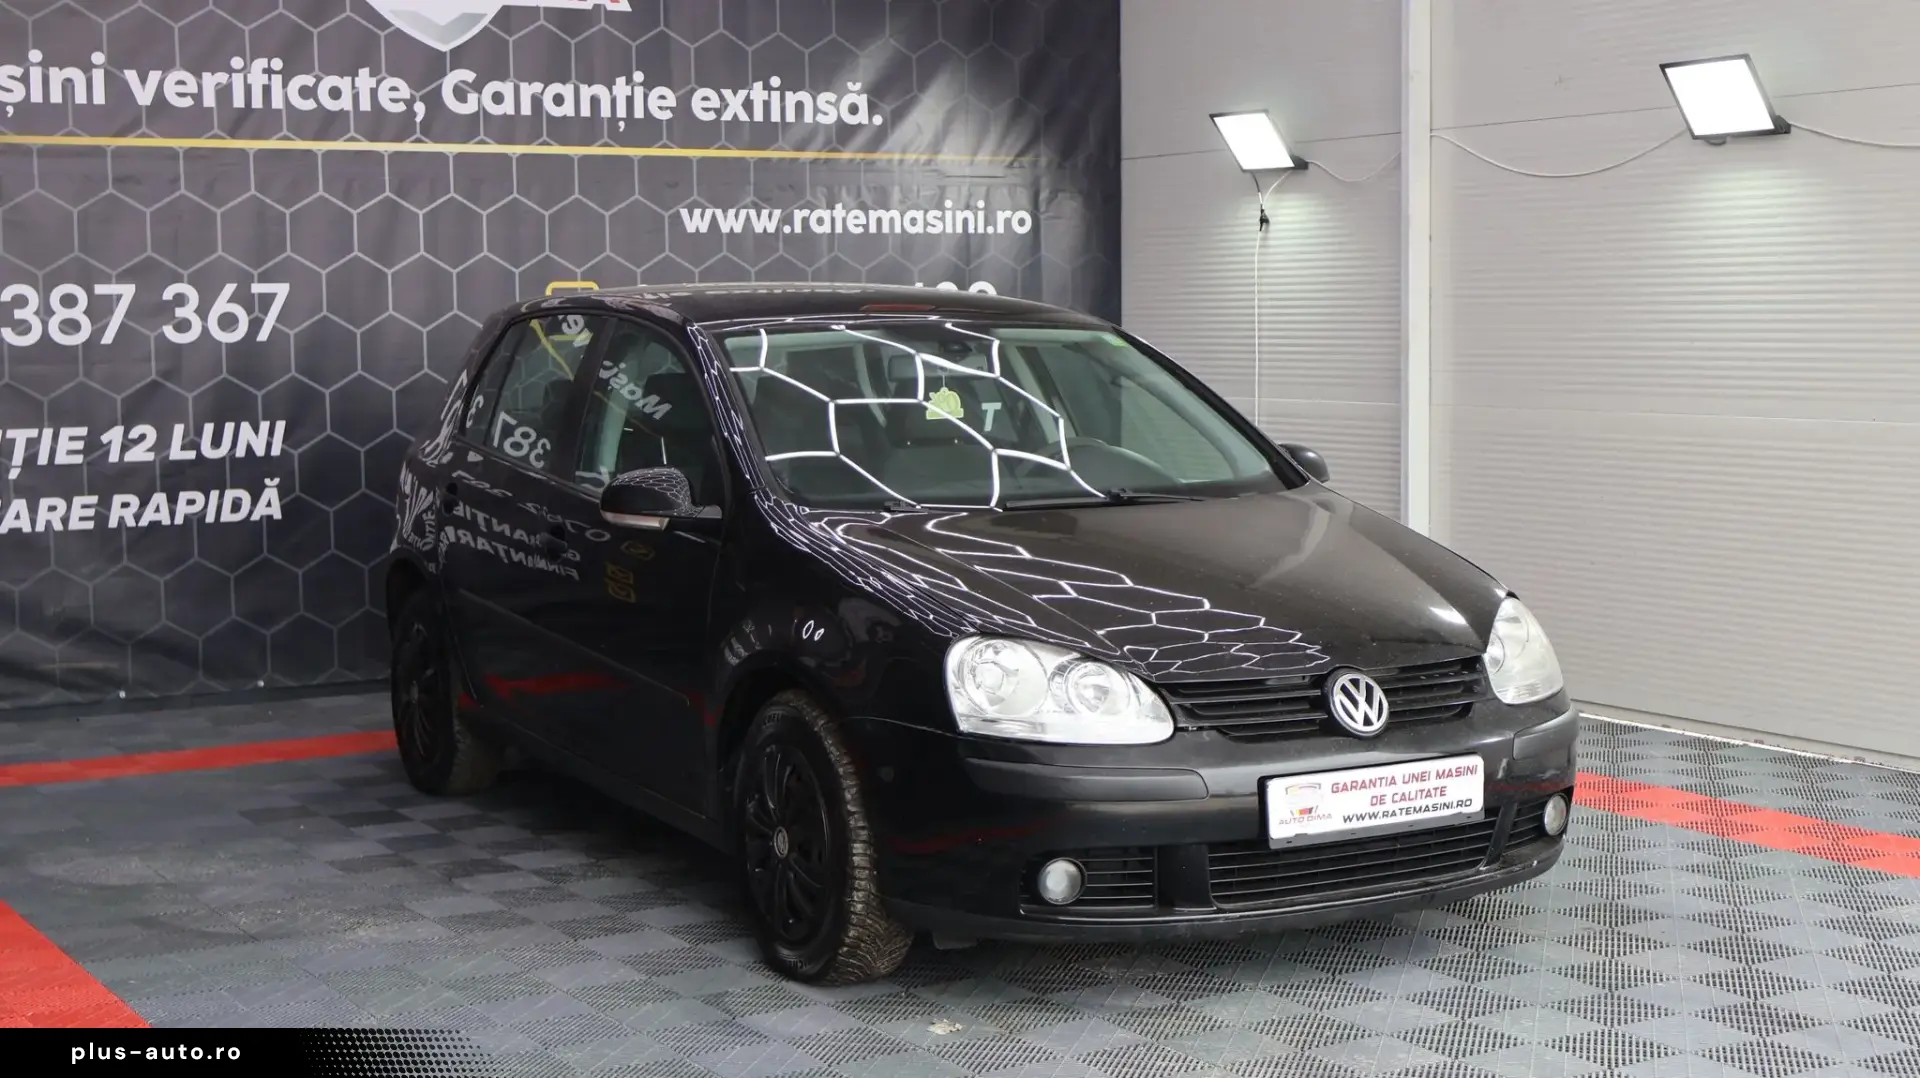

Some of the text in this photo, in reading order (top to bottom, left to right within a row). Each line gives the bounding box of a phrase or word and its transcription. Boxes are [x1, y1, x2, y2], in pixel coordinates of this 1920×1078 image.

[124, 57, 426, 122] verificate,
[441, 68, 674, 132] Garanție
[691, 76, 884, 126] extinsă.
[680, 200, 1033, 235] www.ratemasini.ro
[0, 282, 290, 347] 387 367
[0, 420, 286, 479] ȚIE 12 LUNI
[0, 477, 283, 534] ARE RAPIDĂ
[1330, 764, 1478, 794] GARANTIA UNEI MASINI
[1369, 786, 1447, 807] DE CALITATE
[1342, 798, 1473, 824] WWW.RATEMASINI.RO
